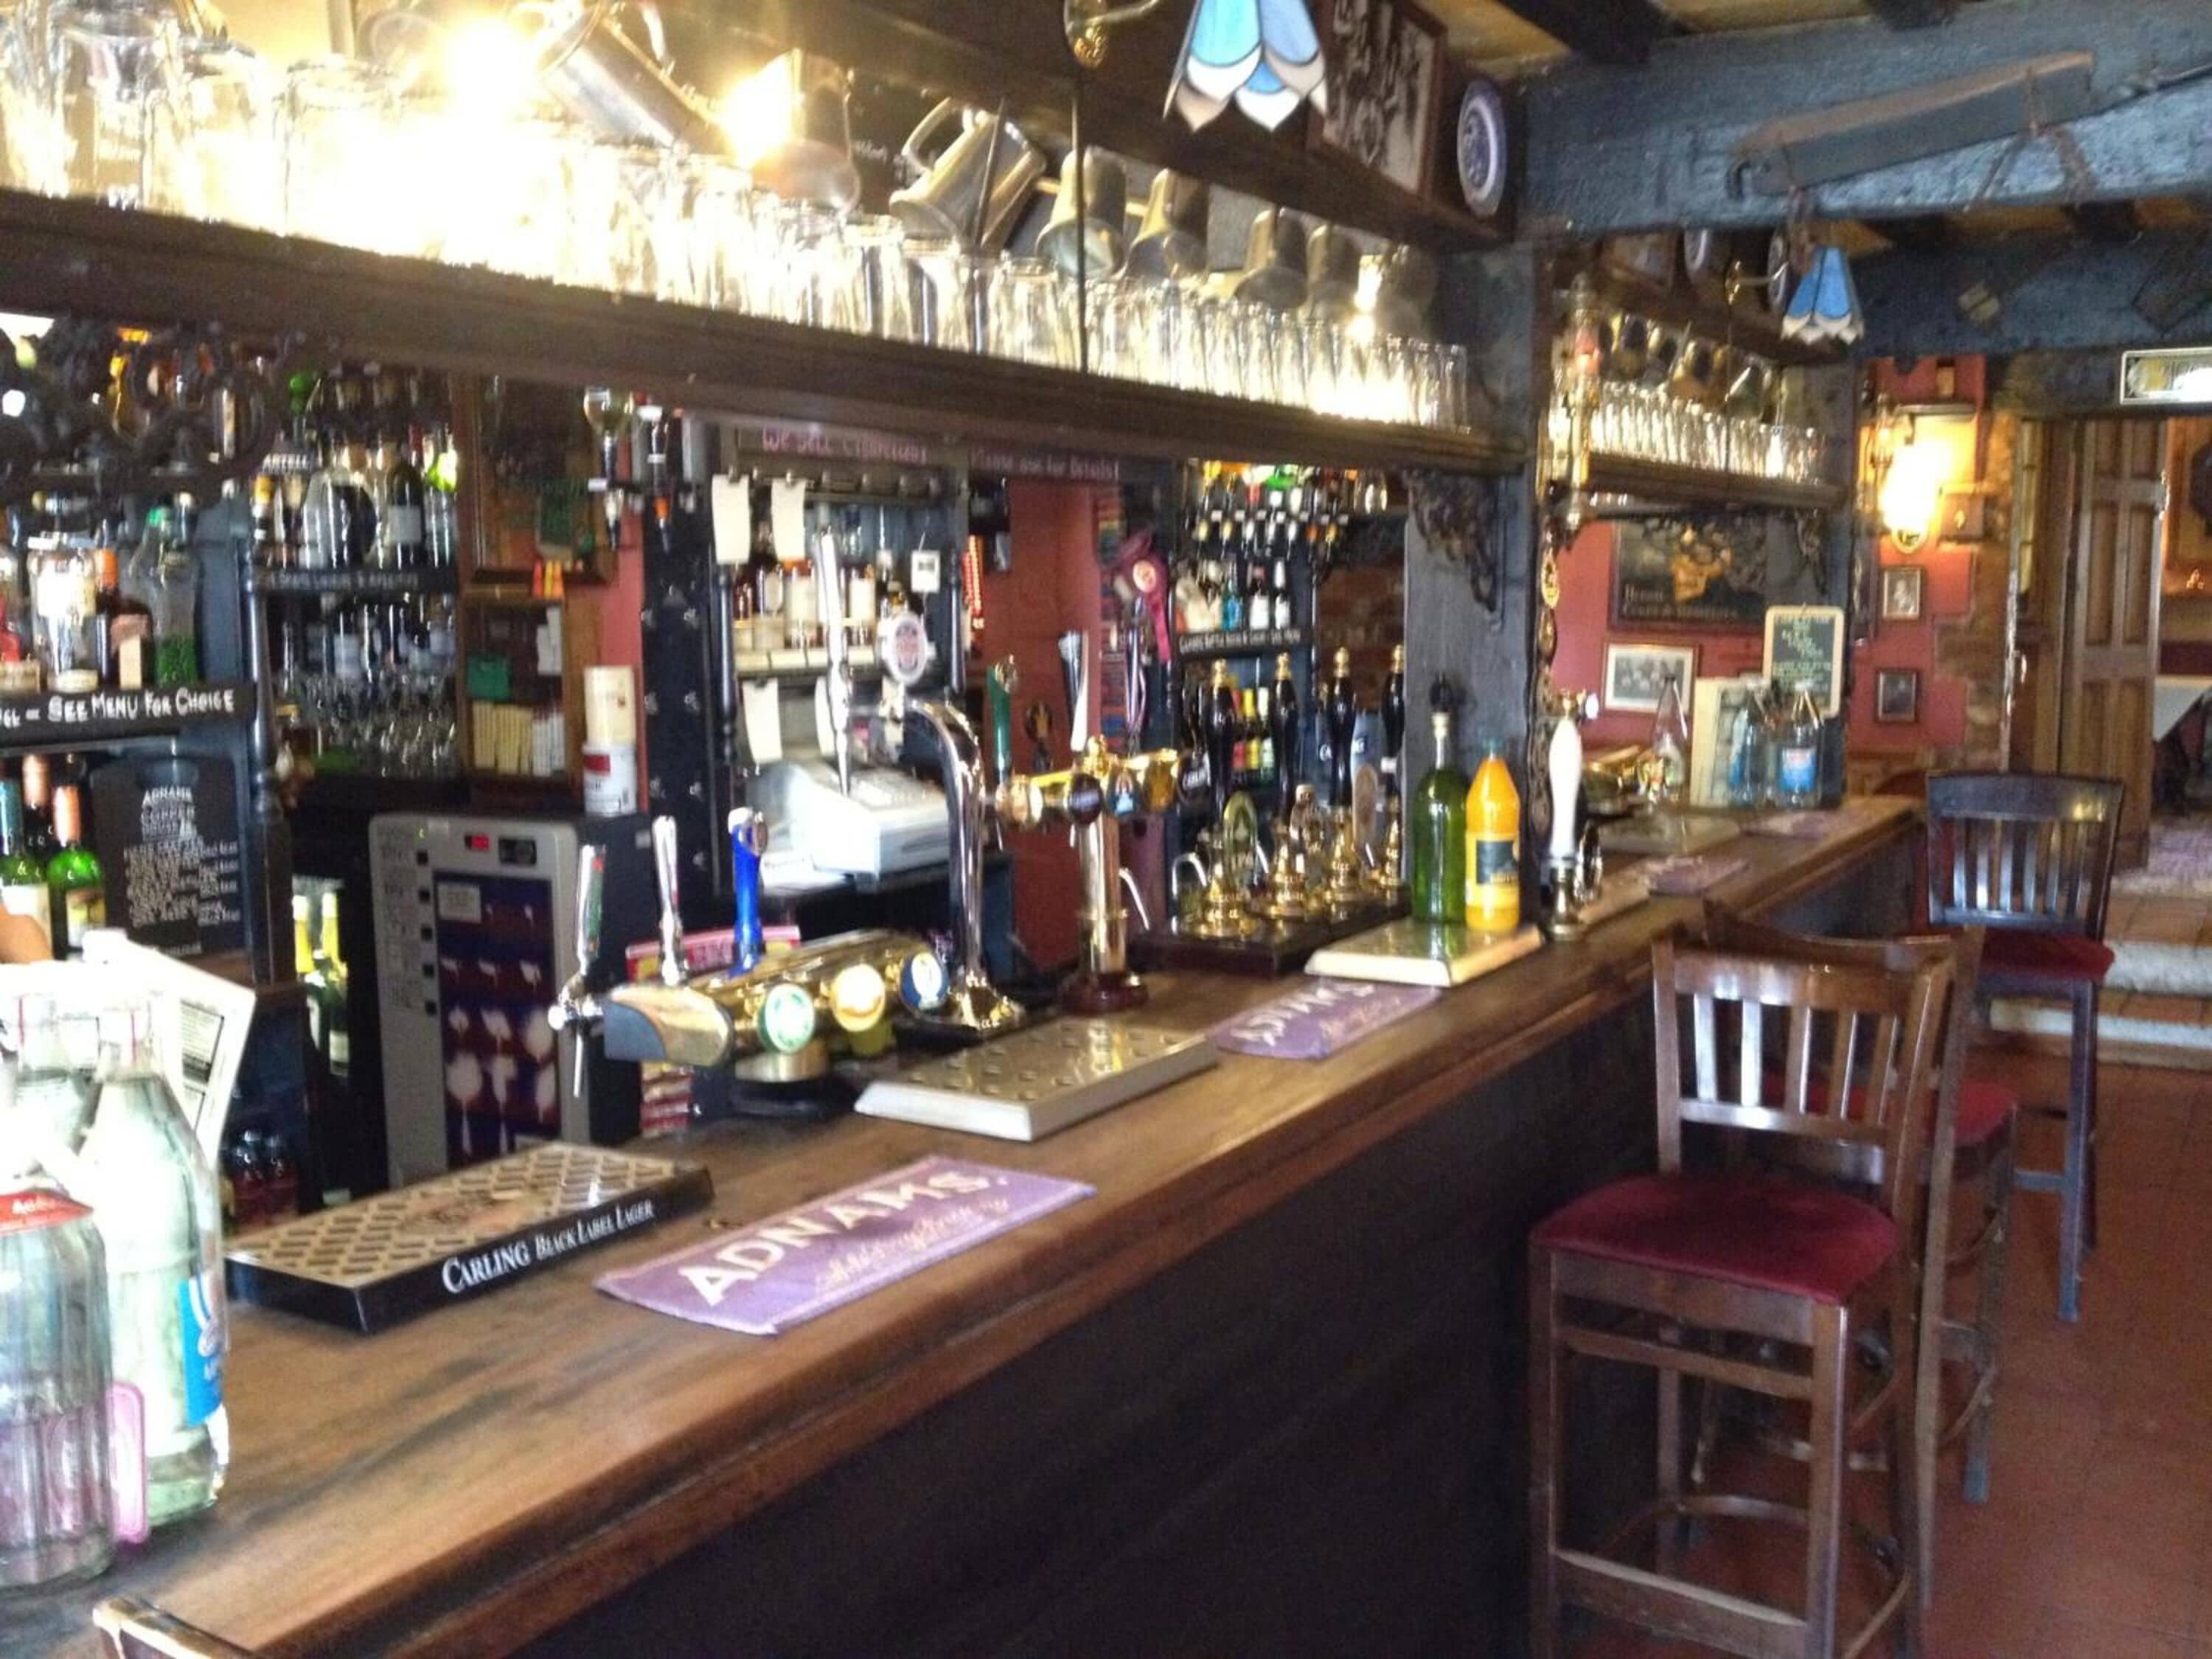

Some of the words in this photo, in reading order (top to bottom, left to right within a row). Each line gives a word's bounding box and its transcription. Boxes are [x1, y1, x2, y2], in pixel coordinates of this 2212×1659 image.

[442, 1240, 531, 1294] CARLING
[535, 1226, 578, 1260] BLACK
[577, 1219, 616, 1244] LABEL
[616, 1199, 655, 1230] LAGER
[678, 1171, 991, 1307] ADNAMS
